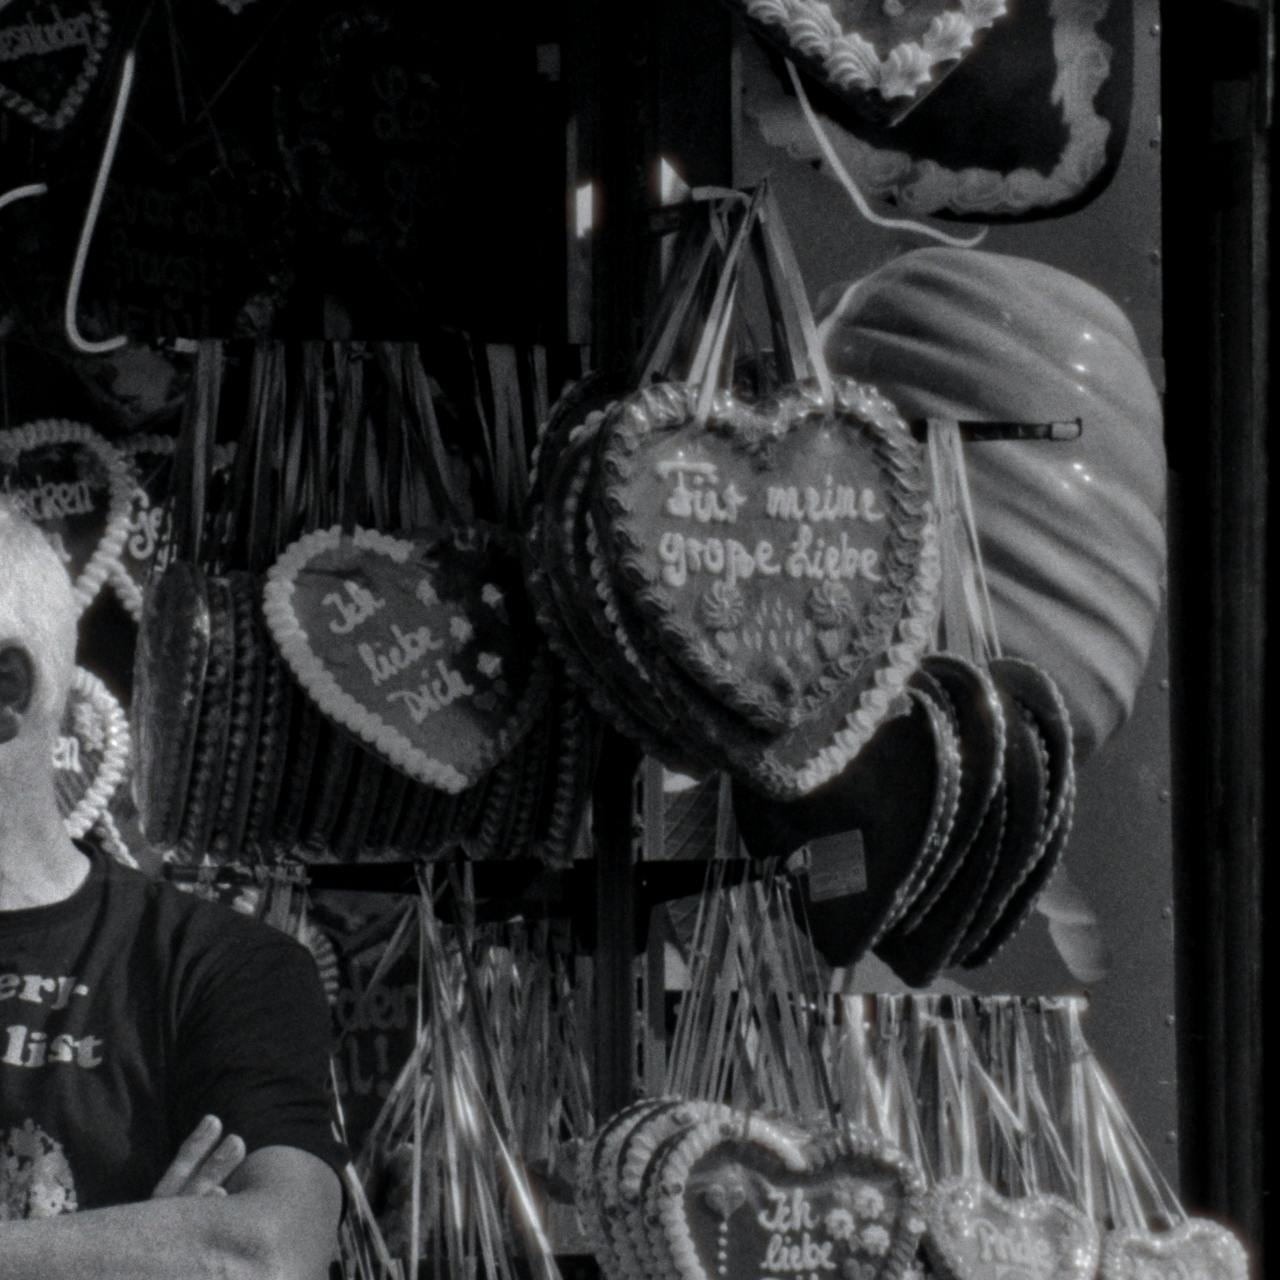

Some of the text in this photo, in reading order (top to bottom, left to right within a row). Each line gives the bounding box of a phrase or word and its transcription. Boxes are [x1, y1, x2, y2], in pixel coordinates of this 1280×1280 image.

[656, 460, 885, 523] Für meine
[785, 523, 883, 581] Liebe
[357, 624, 445, 685] liebe
[386, 660, 475, 725] Dich
[758, 1186, 821, 1232] Ich
[759, 1231, 837, 1271] liebe
